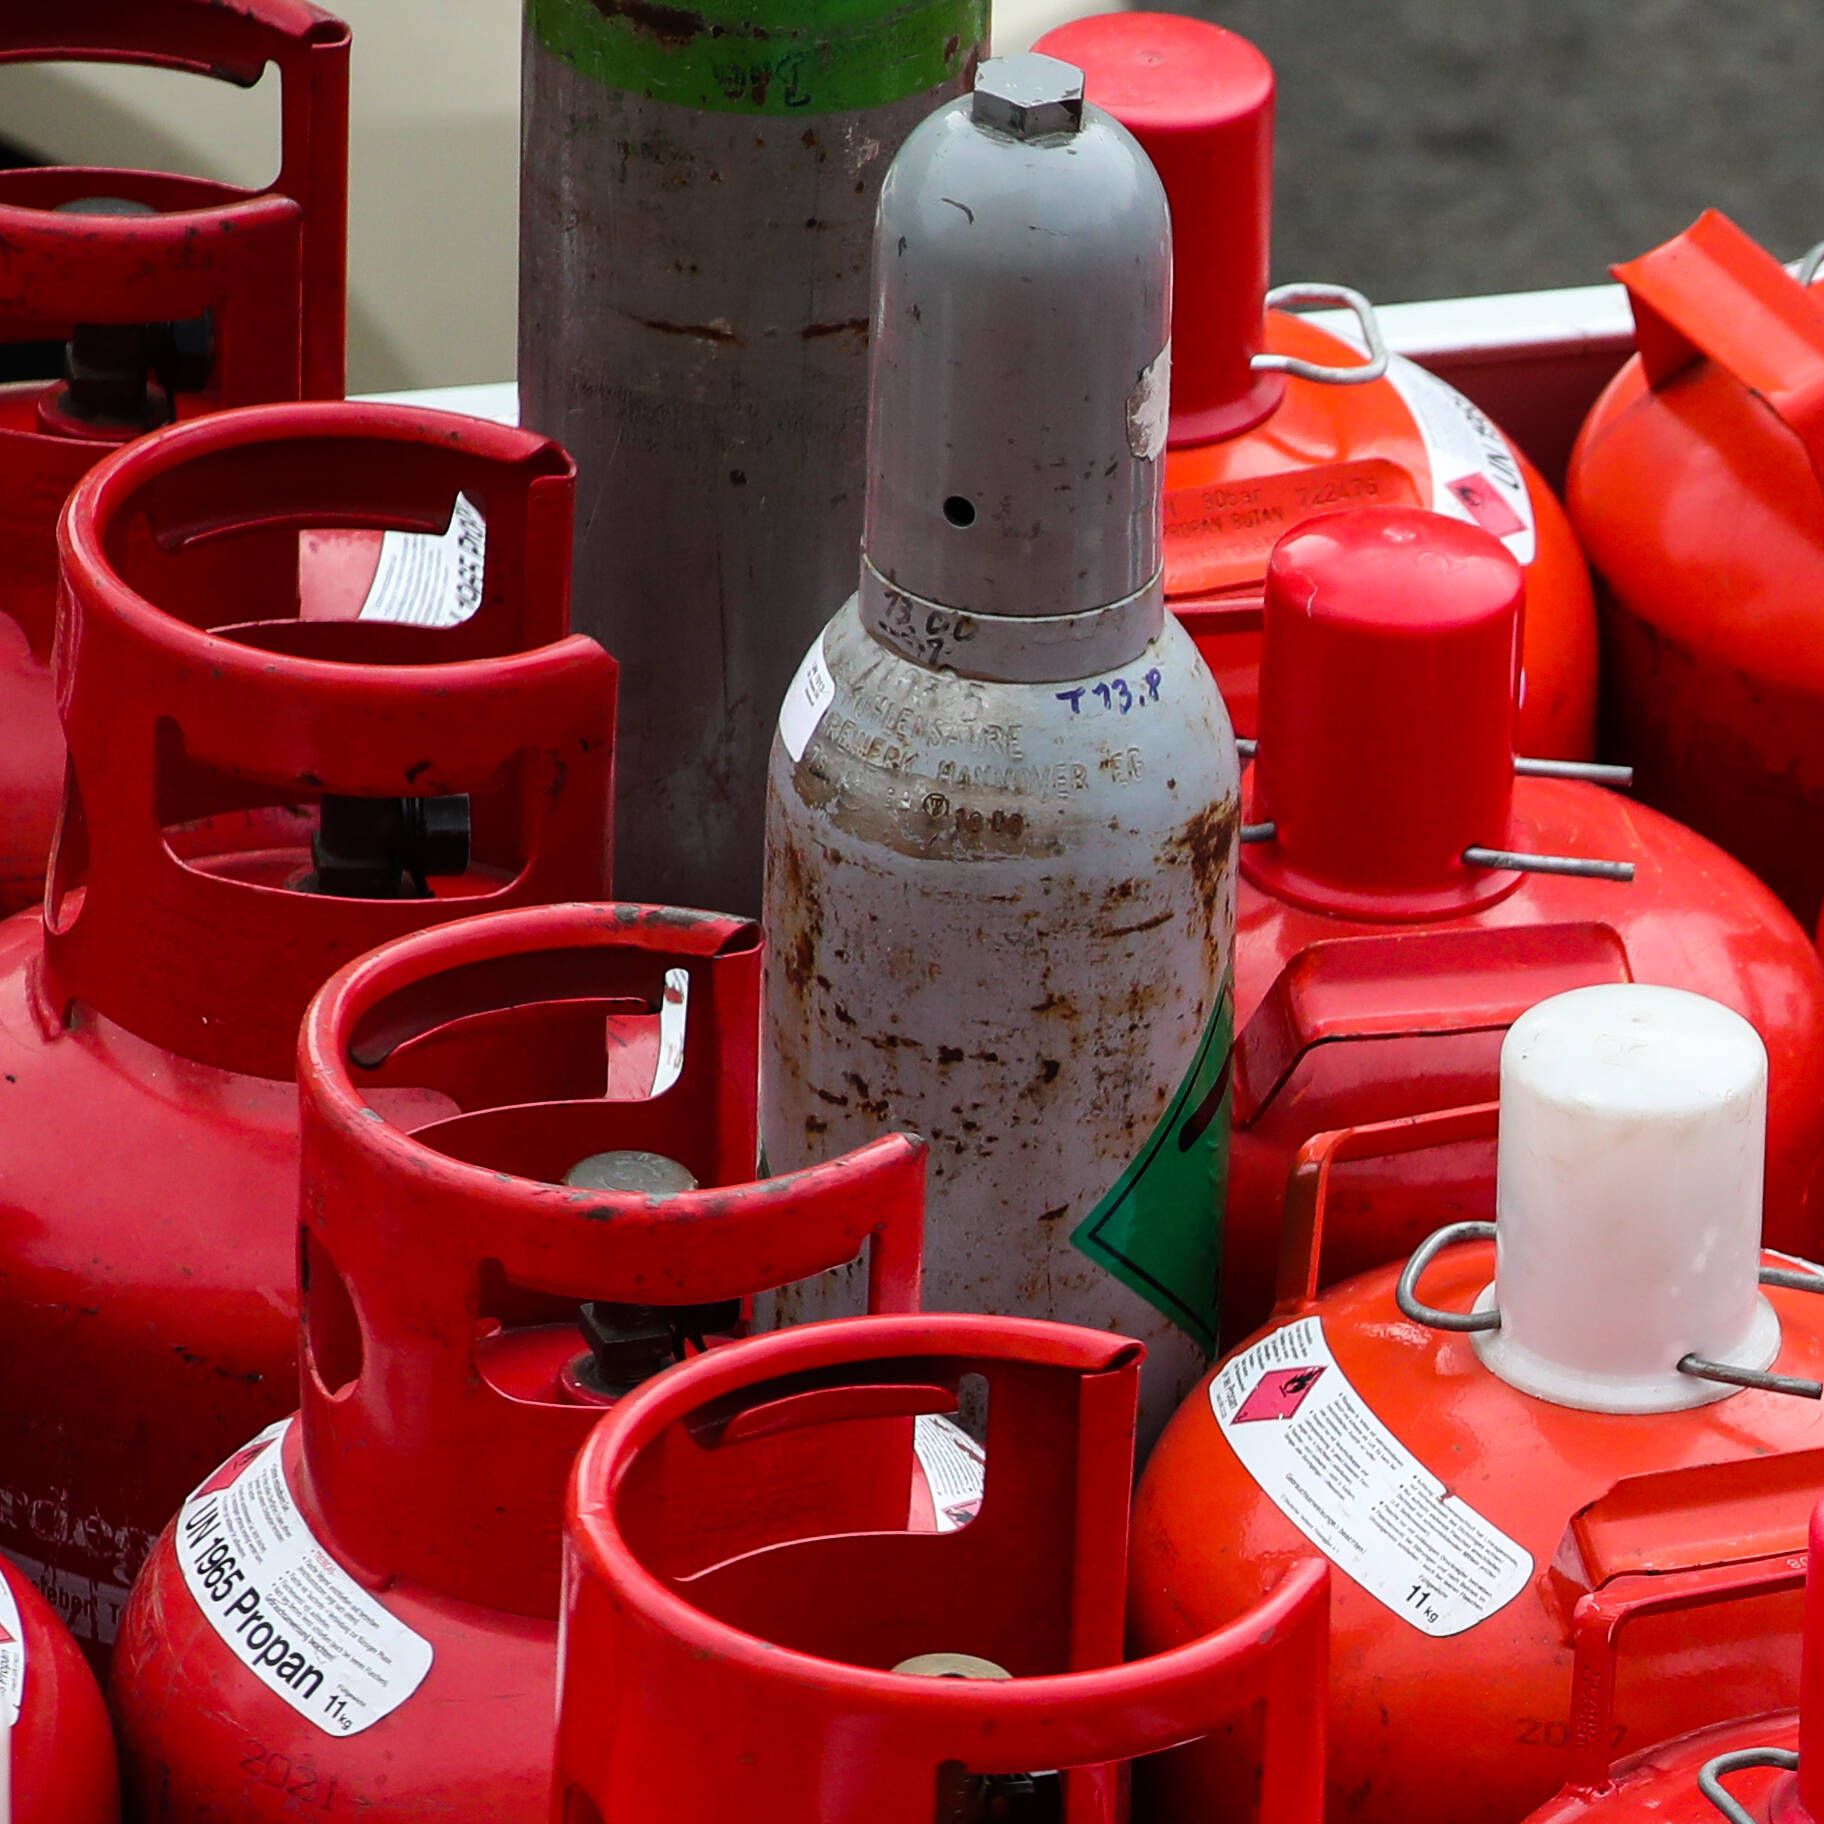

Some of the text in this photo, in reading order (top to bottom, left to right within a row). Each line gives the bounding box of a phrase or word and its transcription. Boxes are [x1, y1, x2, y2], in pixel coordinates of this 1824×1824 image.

[184, 1496, 219, 1552] UN
[192, 1536, 245, 1604] 1965
[228, 1585, 325, 1700] Propan
[1514, 1717, 1628, 1749] 207
[239, 1739, 339, 1813] 2021
